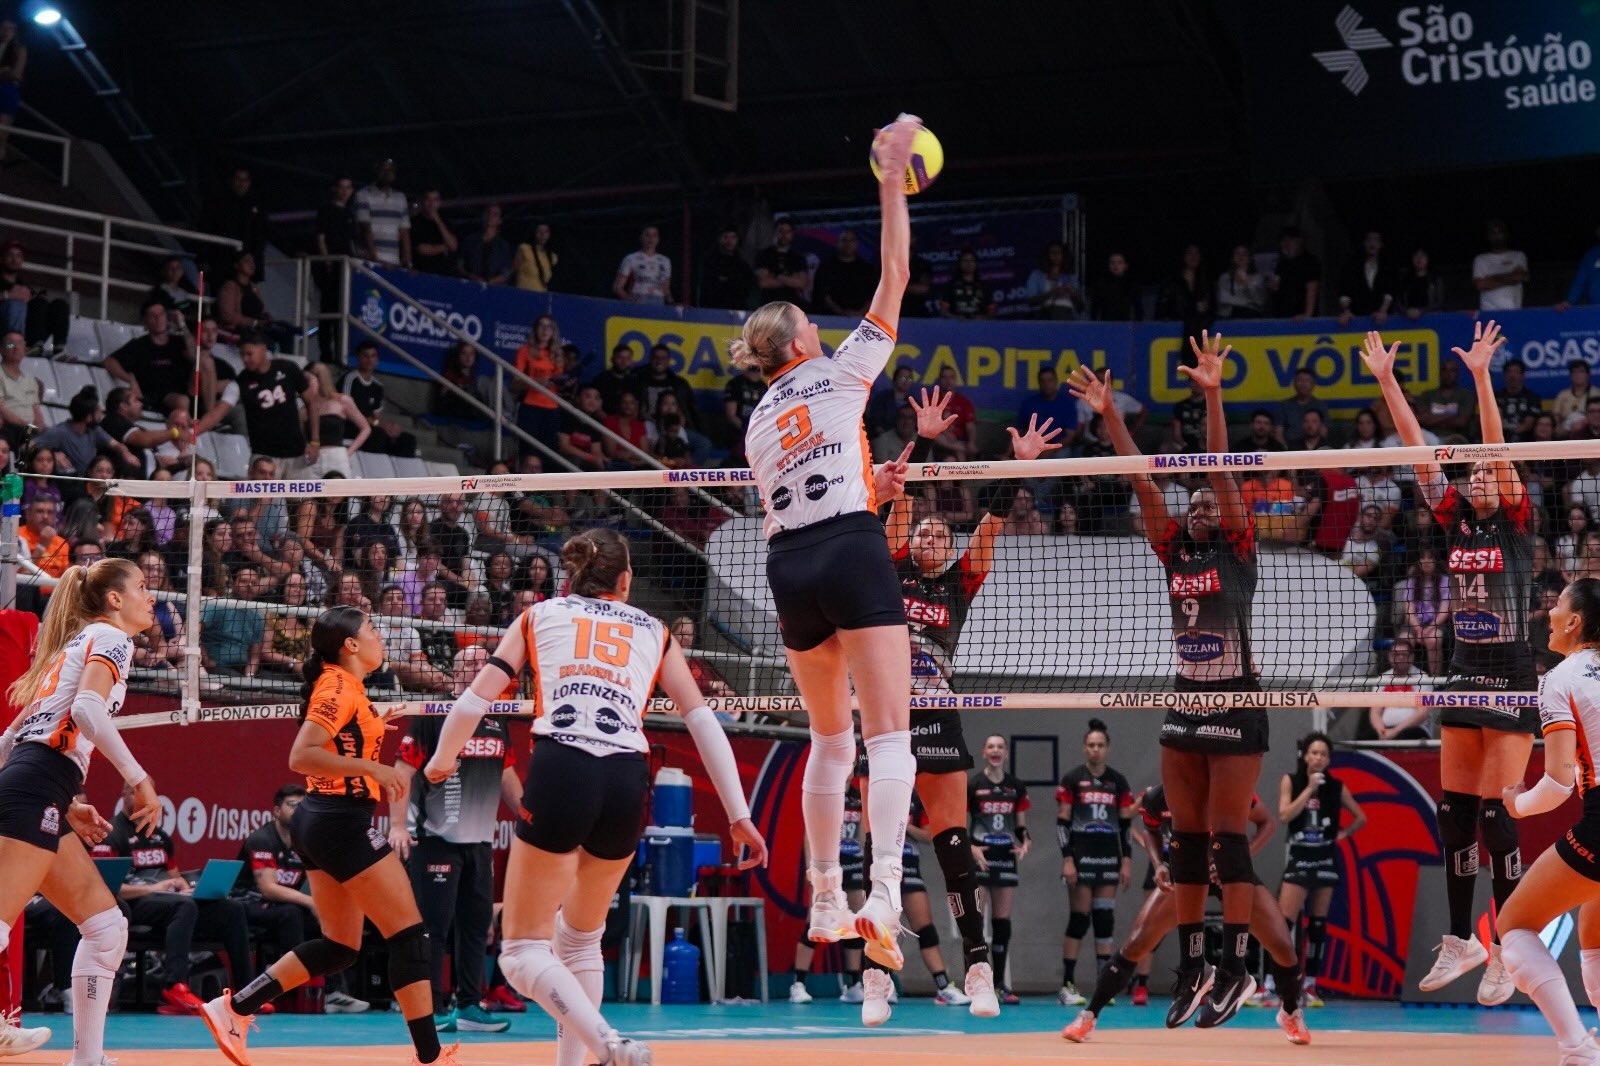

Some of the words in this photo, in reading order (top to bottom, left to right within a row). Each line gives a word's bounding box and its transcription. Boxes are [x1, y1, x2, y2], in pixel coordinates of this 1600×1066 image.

[1397, 4, 1473, 47] São
[1402, 32, 1592, 85] Cristóvão
[1505, 74, 1596, 109] saúde
[389, 302, 483, 342] OSASCO
[1521, 338, 1600, 368] OSAS
[884, 344, 1124, 391] CAPITAL
[1265, 336, 1429, 388] VÔLEI
[258, 385, 286, 408] 34
[776, 404, 812, 450] 3
[1155, 455, 1217, 468] MASTER
[1223, 454, 1264, 466] REDE
[669, 471, 724, 482] MASTER
[730, 470, 756, 481] RE
[235, 482, 286, 493] MASTER
[290, 482, 322, 493] REDE
[805, 475, 844, 494] Edenred
[1449, 549, 1496, 569] SESI
[1455, 574, 1488, 602] 14
[1181, 598, 1200, 627] 9
[572, 617, 634, 668] 15
[112, 647, 127, 662] PRO
[425, 703, 454, 713] MAS
[725, 697, 802, 710] PAULISTA
[910, 697, 957, 707] ASTER
[963, 696, 1002, 707] REDE
[1100, 692, 1226, 708] CAMPEONATO
[1233, 692, 1319, 707] PAULISTA
[1422, 695, 1489, 706] MASTER
[1495, 695, 1538, 706] REDE
[170, 706, 271, 721] CPEONATO
[321, 703, 338, 714] PRO
[911, 723, 941, 736] delli
[465, 739, 500, 755] SESI
[1084, 792, 1114, 803] SESI
[983, 802, 1013, 813] SESI
[1090, 804, 1108, 820] 16
[842, 823, 857, 838] 19
[992, 814, 1005, 831] 8
[137, 852, 165, 865] SESI
[430, 864, 449, 872] SESI
